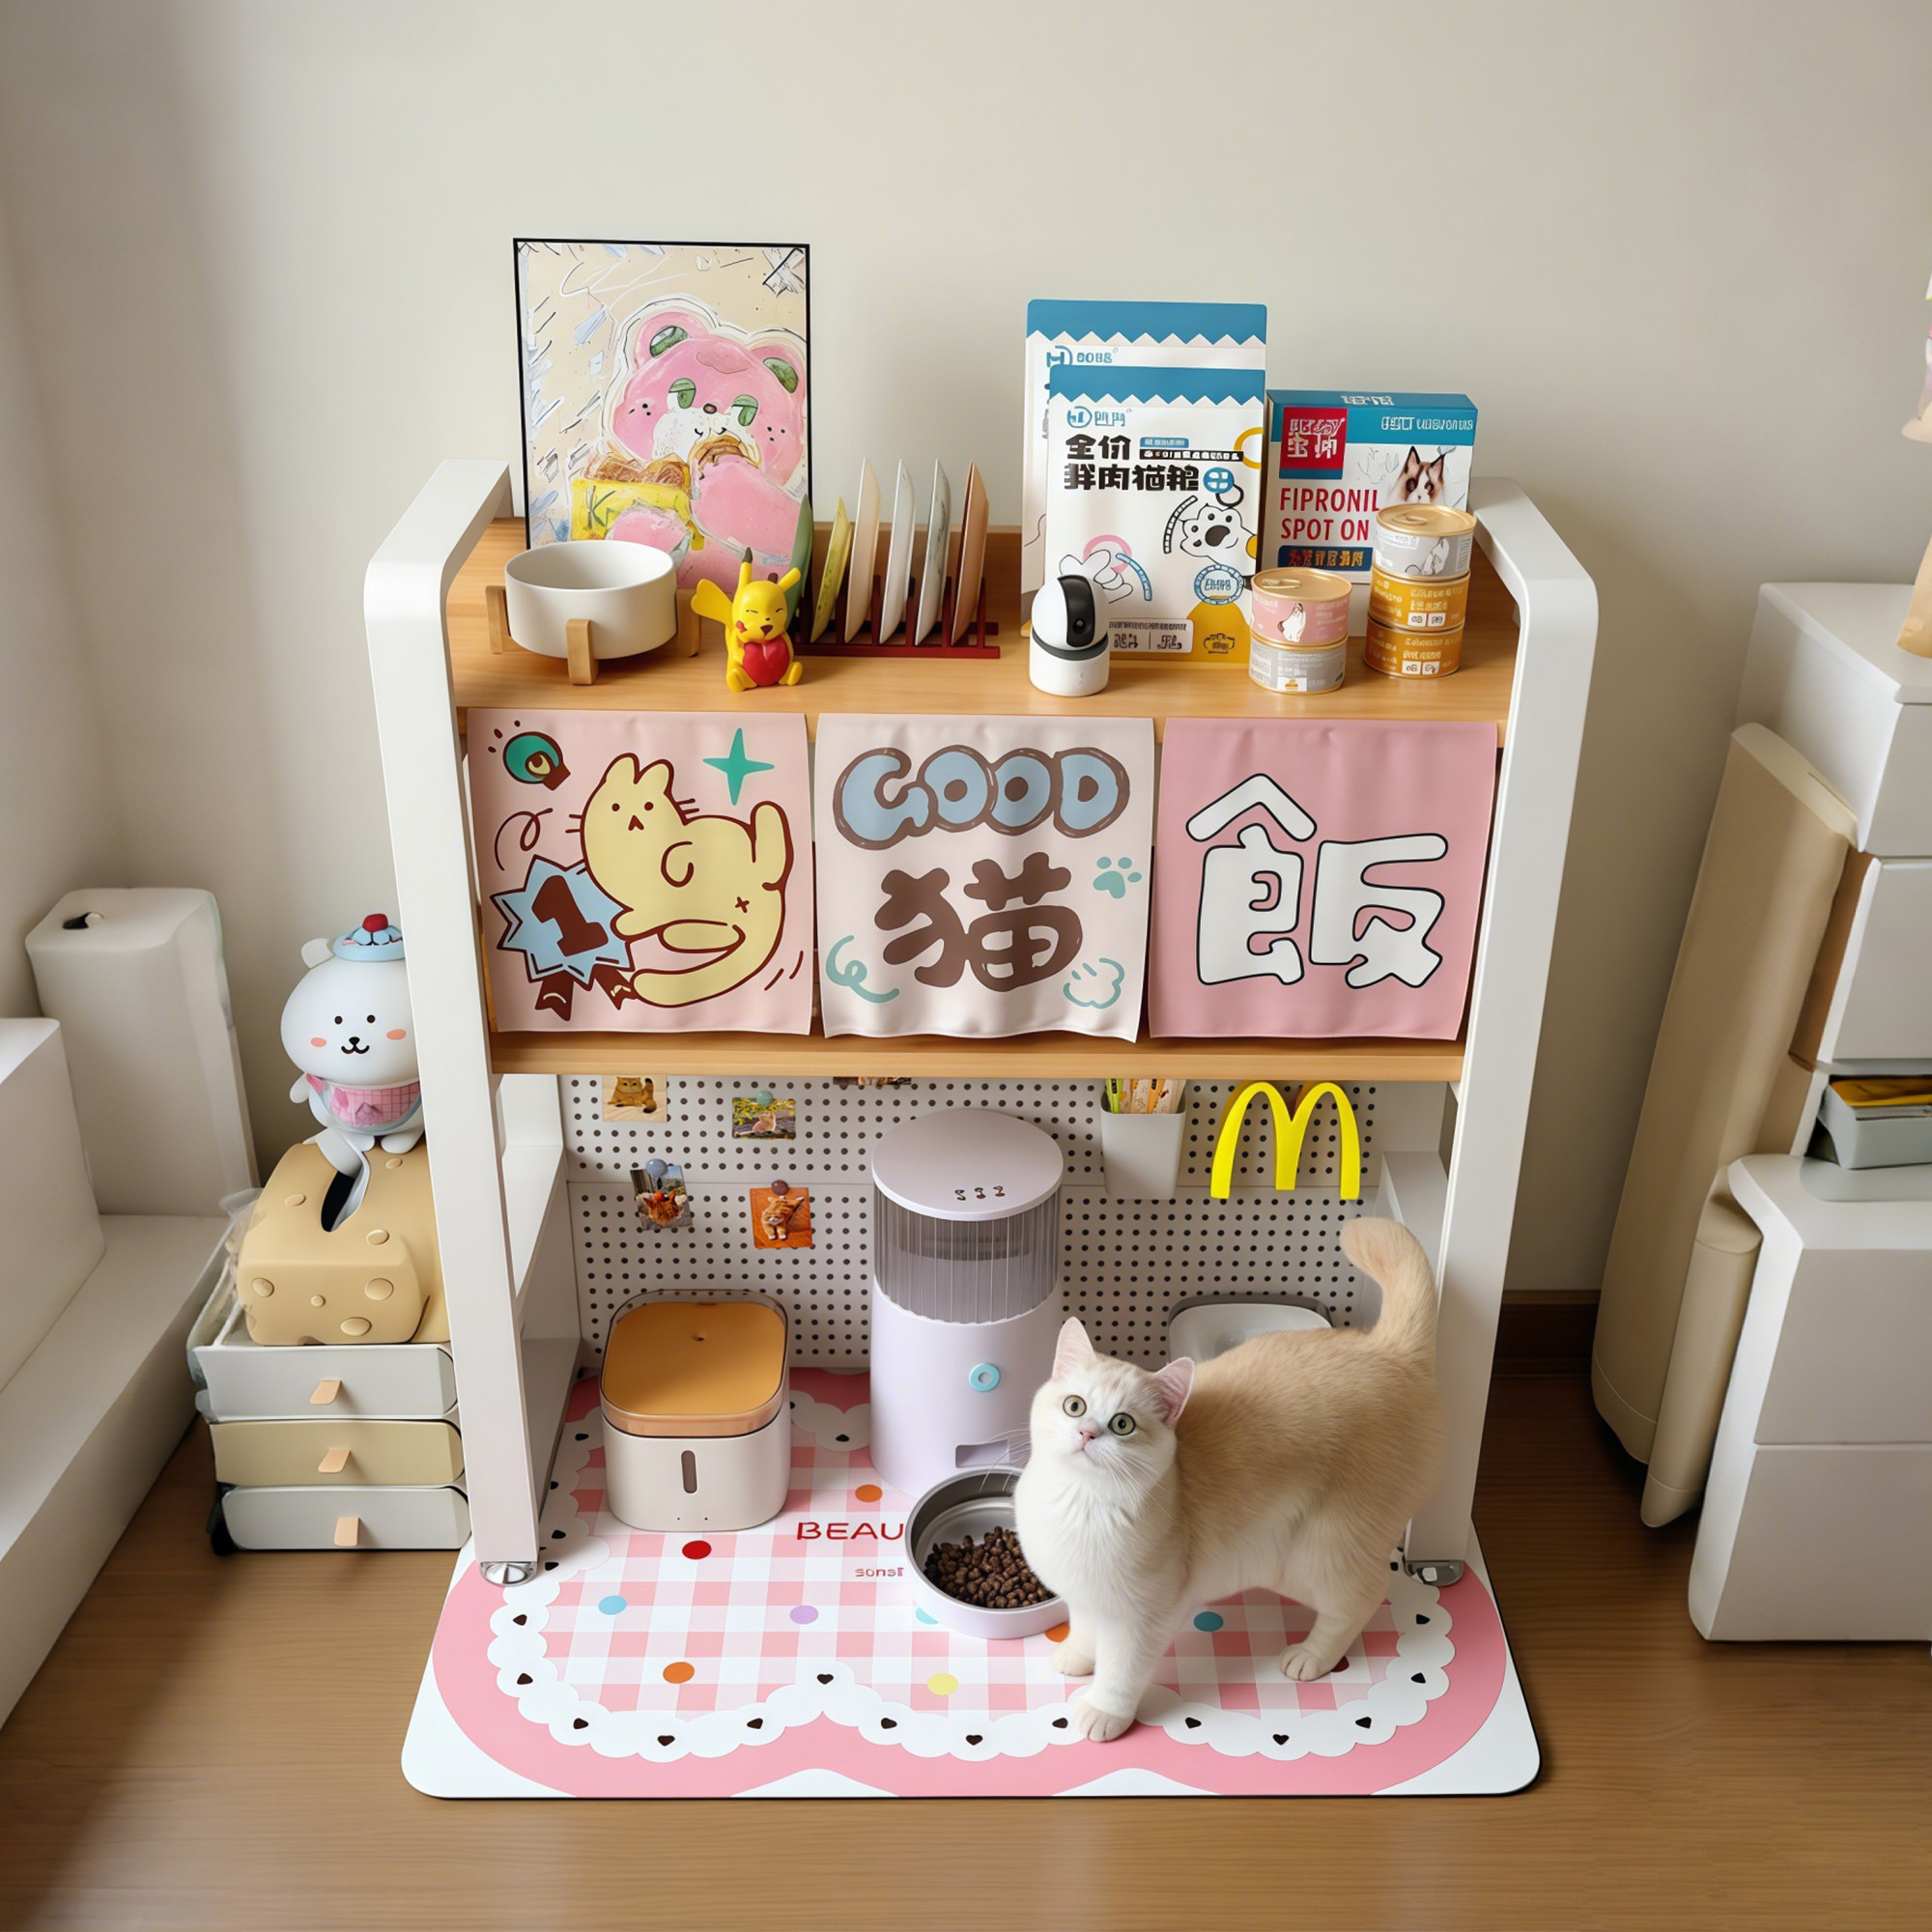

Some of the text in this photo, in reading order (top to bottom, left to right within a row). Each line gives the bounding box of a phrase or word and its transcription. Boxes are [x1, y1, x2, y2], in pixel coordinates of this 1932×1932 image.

[1280, 488, 1379, 512] FIPRONIL
[1281, 518, 1333, 541] SPOT
[1341, 519, 1370, 541] ON
[833, 745, 1130, 850] GOOD
[531, 875, 609, 956] 1
[874, 852, 1083, 992] 猫
[797, 1521, 904, 1541] BEAU
